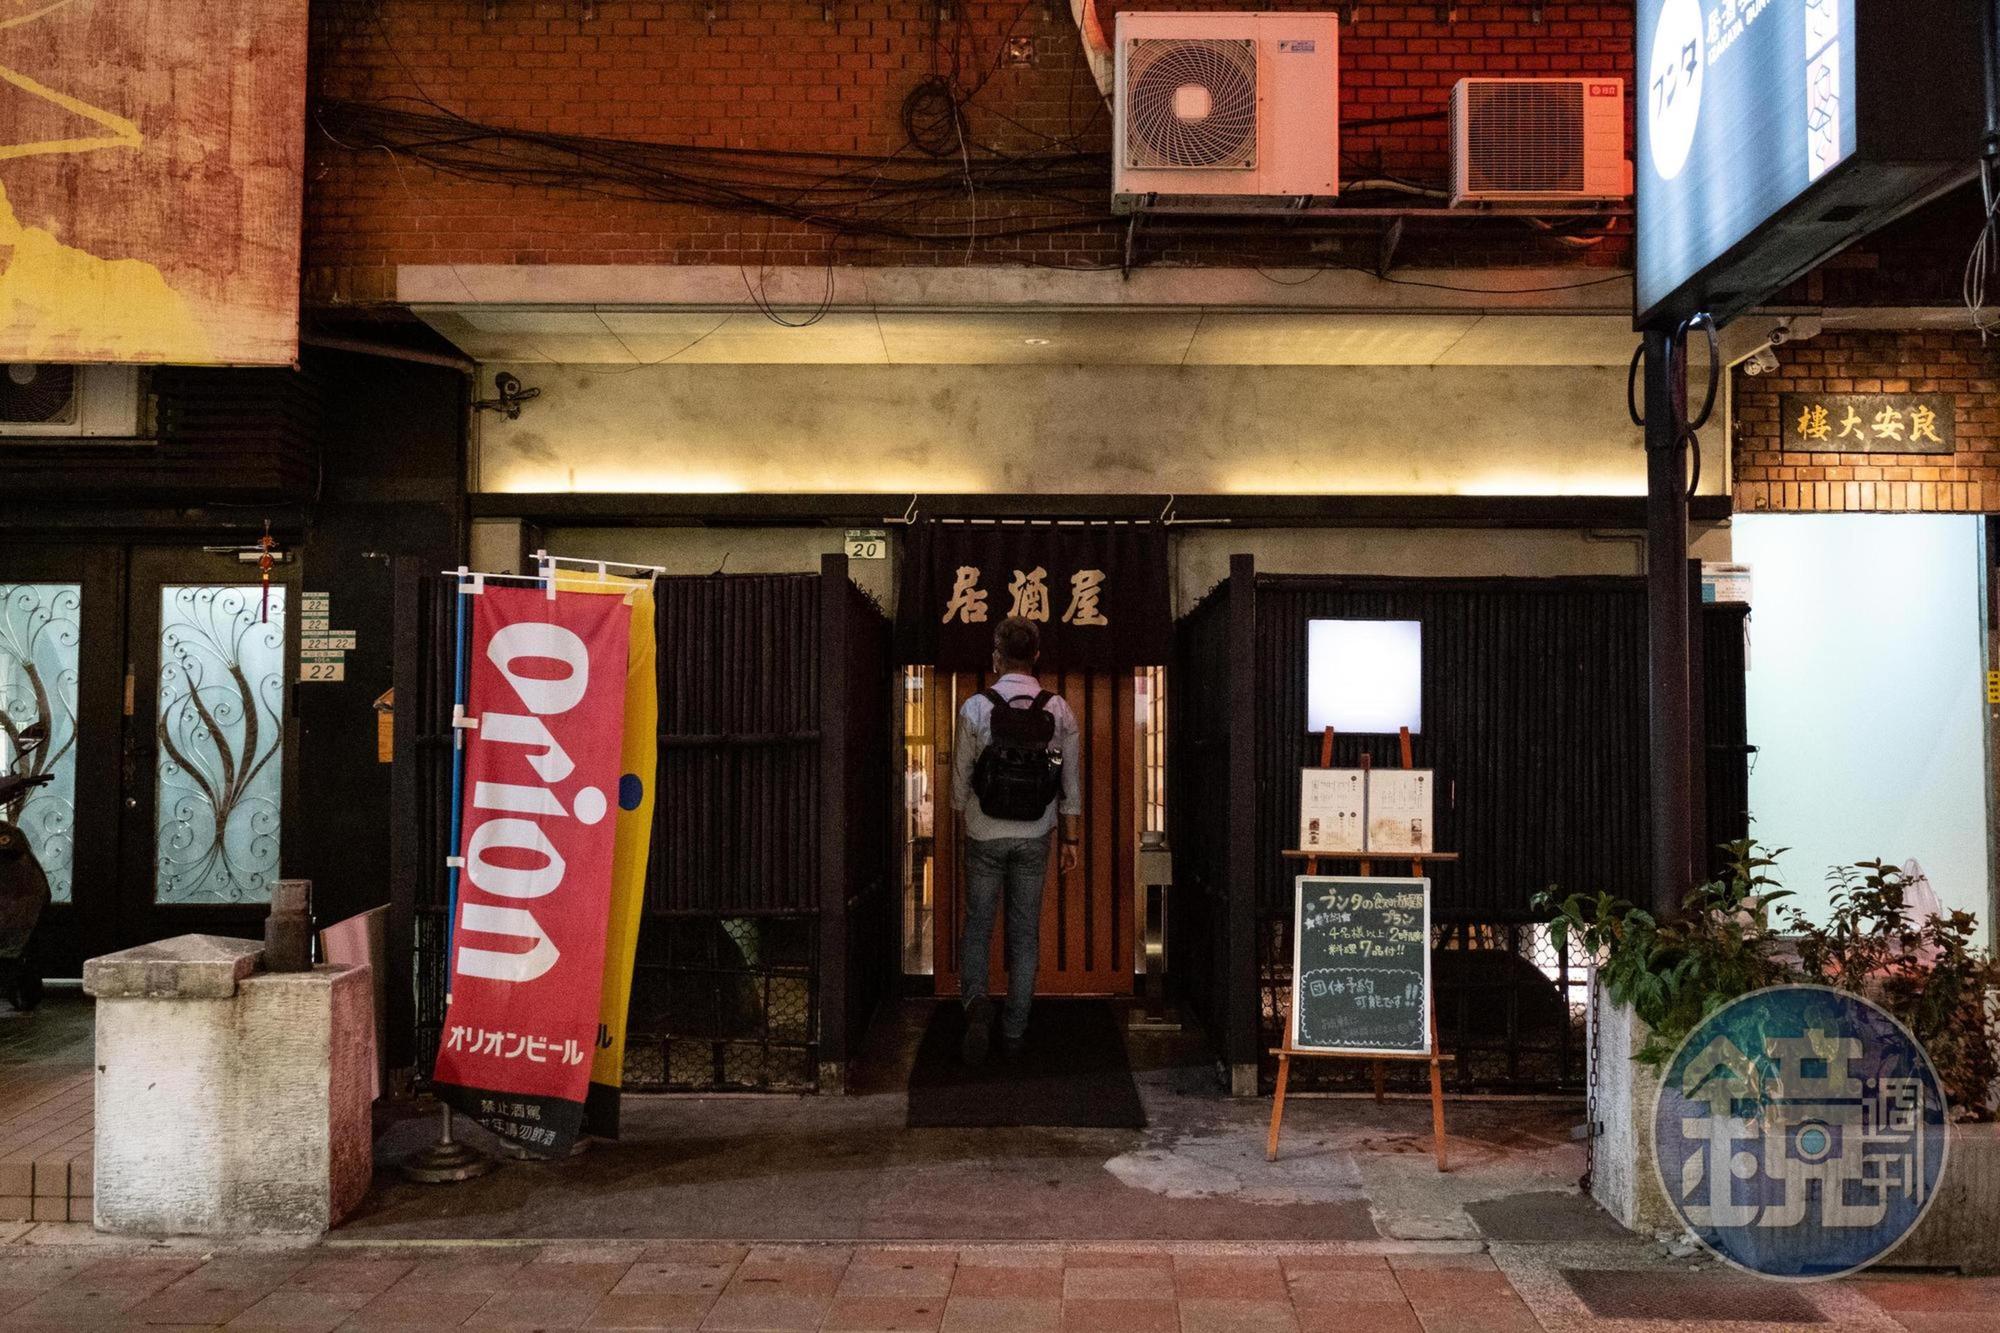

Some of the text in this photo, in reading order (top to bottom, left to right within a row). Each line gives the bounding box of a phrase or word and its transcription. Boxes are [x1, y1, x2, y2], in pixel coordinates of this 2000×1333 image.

[853, 543, 877, 557] 20
[942, 565, 1109, 626] 居酒屋
[308, 601, 322, 610] 22
[308, 620, 321, 630] 22
[308, 639, 321, 648] 22
[335, 639, 349, 648] 22
[310, 665, 335, 679] 22
[457, 622, 607, 982] orion
[447, 1025, 585, 1066] オリオンビール
